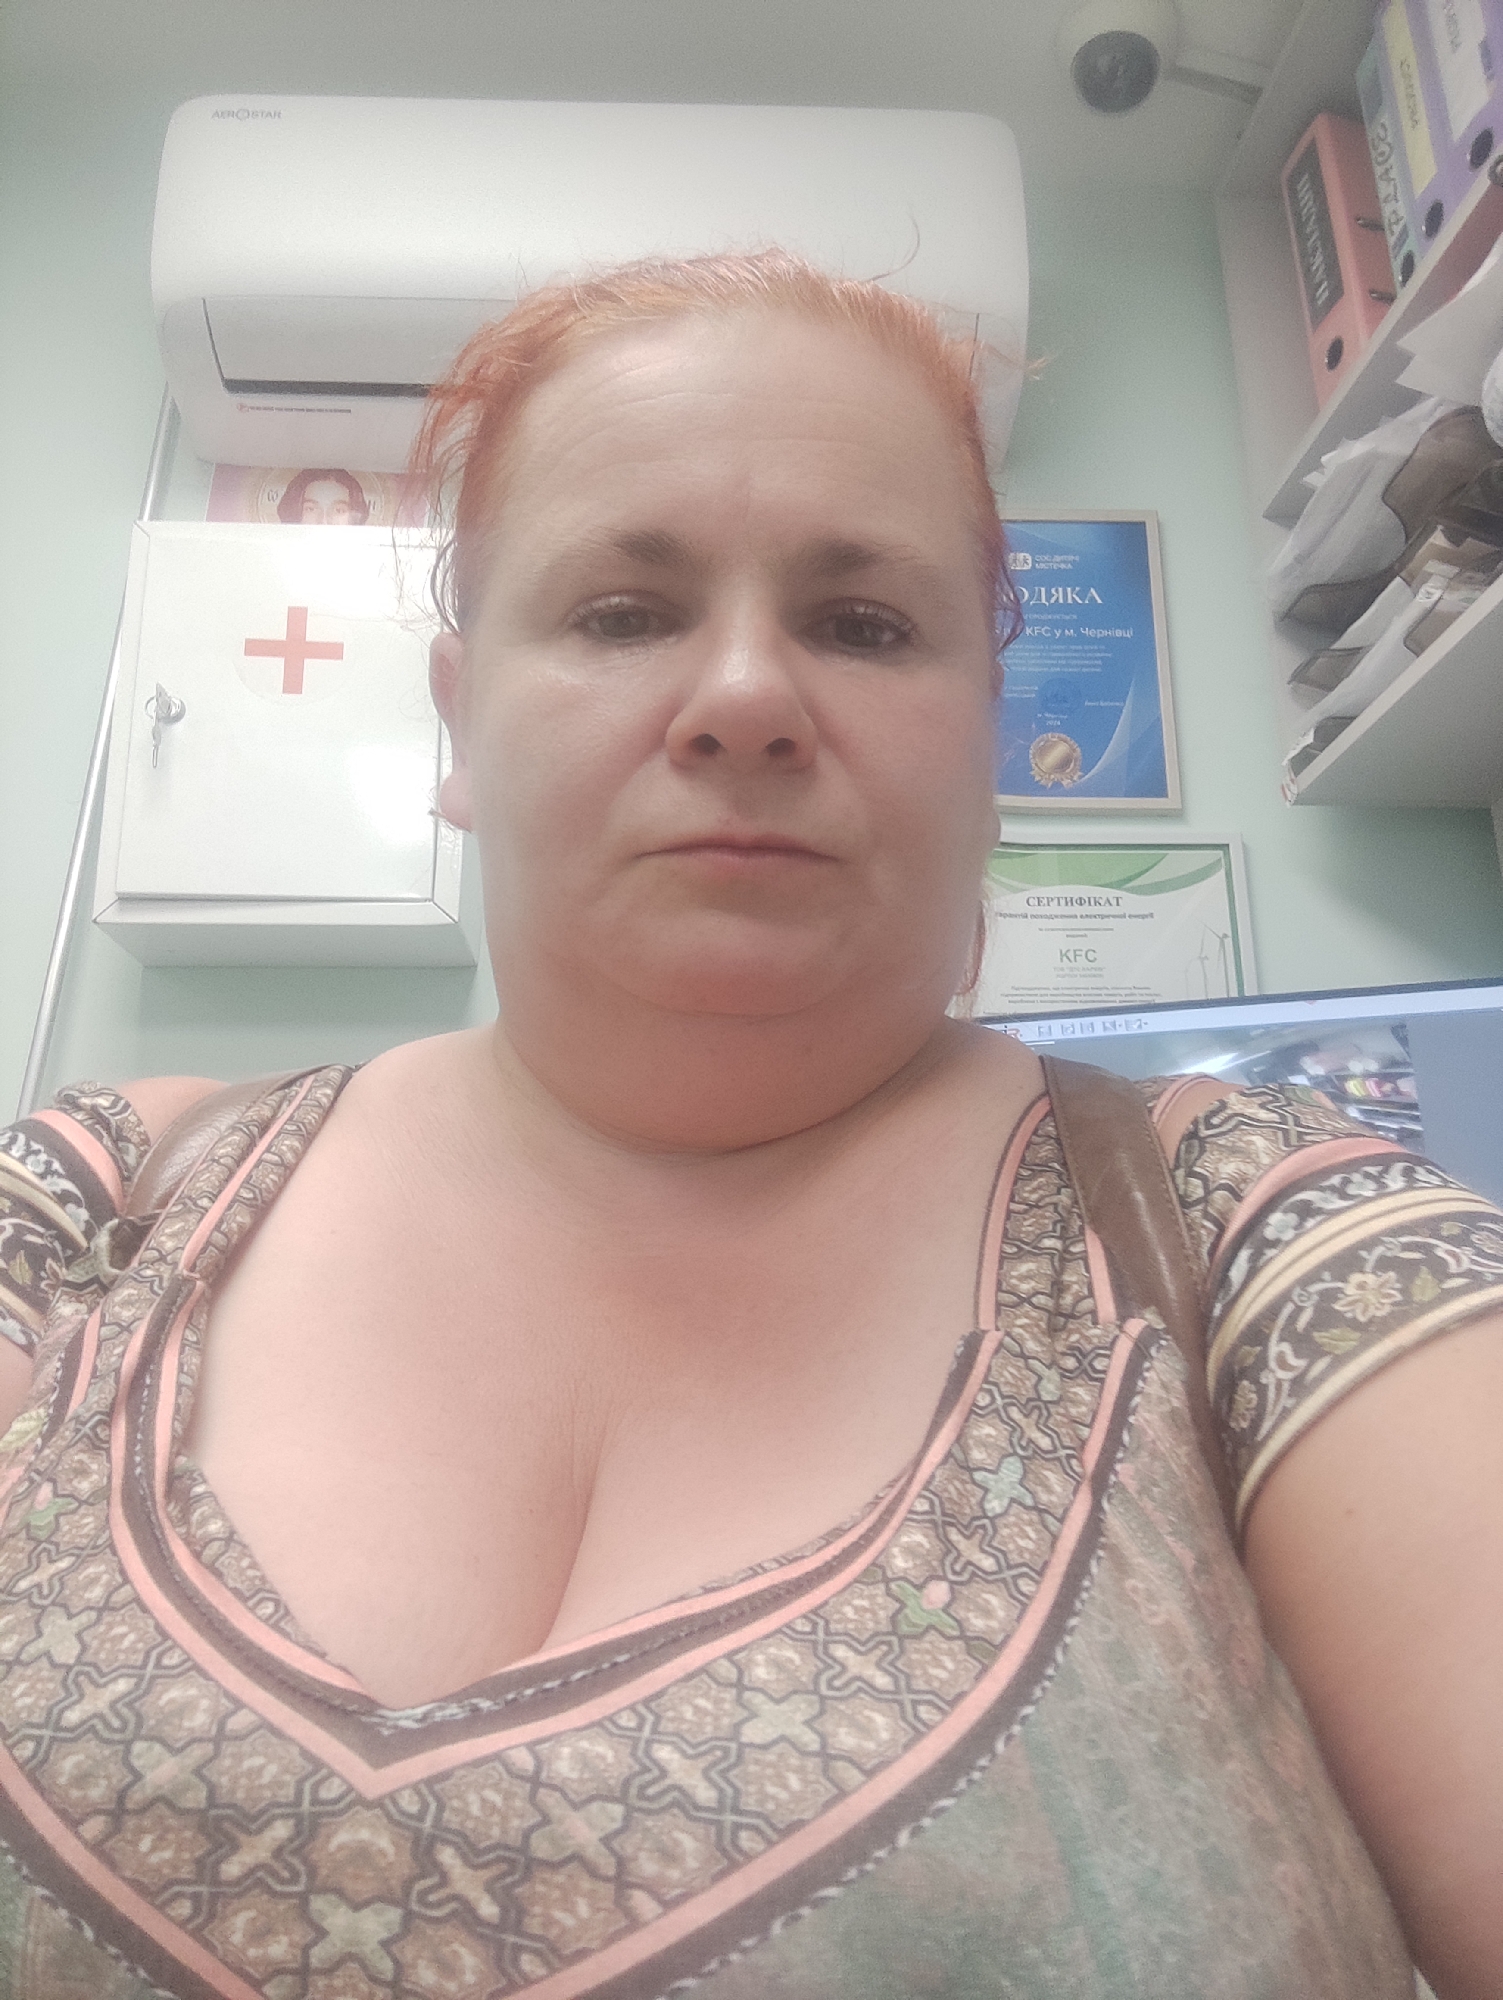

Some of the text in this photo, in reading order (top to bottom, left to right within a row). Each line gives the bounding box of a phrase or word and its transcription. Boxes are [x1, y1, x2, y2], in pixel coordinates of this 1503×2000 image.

[1014, 586, 1103, 606] ОДЯКА
[1025, 626, 1051, 637] KFC
[1065, 629, 1077, 637] м.
[1080, 627, 1133, 639] Чернівці
[1026, 896, 1123, 907] СЕРТИФІКАТ
[1059, 949, 1097, 963] KFC
